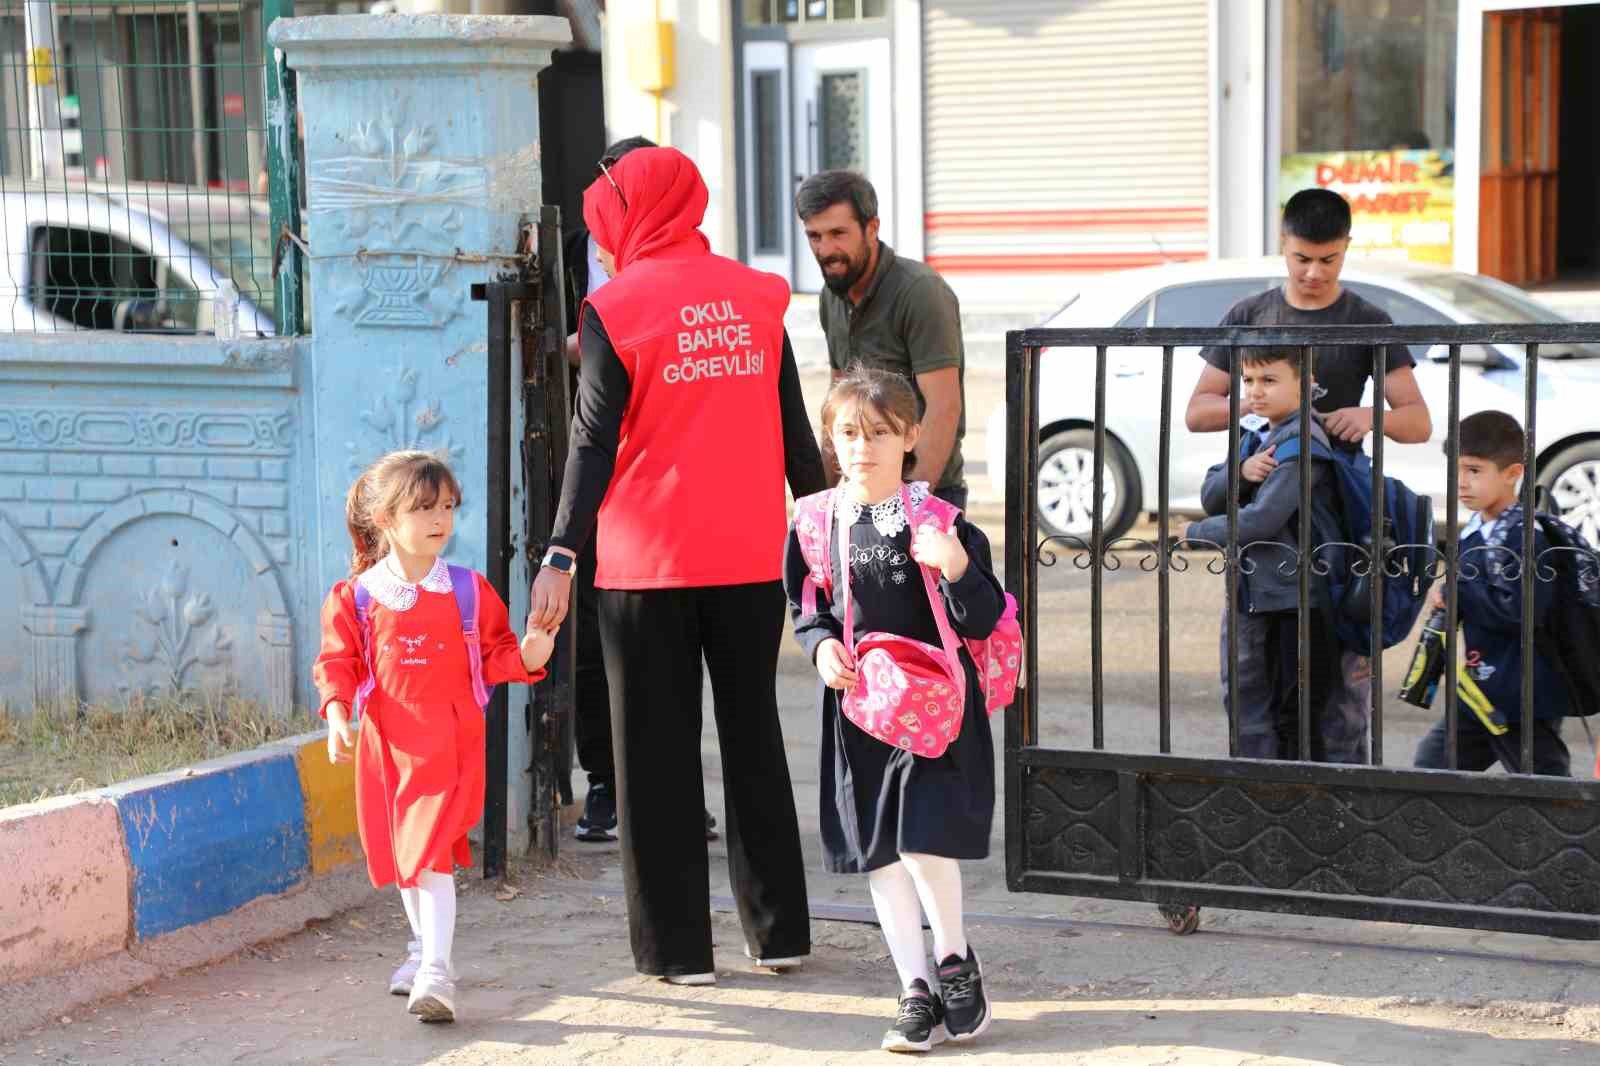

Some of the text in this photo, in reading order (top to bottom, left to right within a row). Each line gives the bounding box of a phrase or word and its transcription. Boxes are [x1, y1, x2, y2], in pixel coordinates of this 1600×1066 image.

[1343, 191, 1431, 215] ARKET
[680, 299, 742, 327] OKUL
[677, 323, 752, 353] BAHÇE
[662, 348, 764, 384] GÖREVLİSİ
